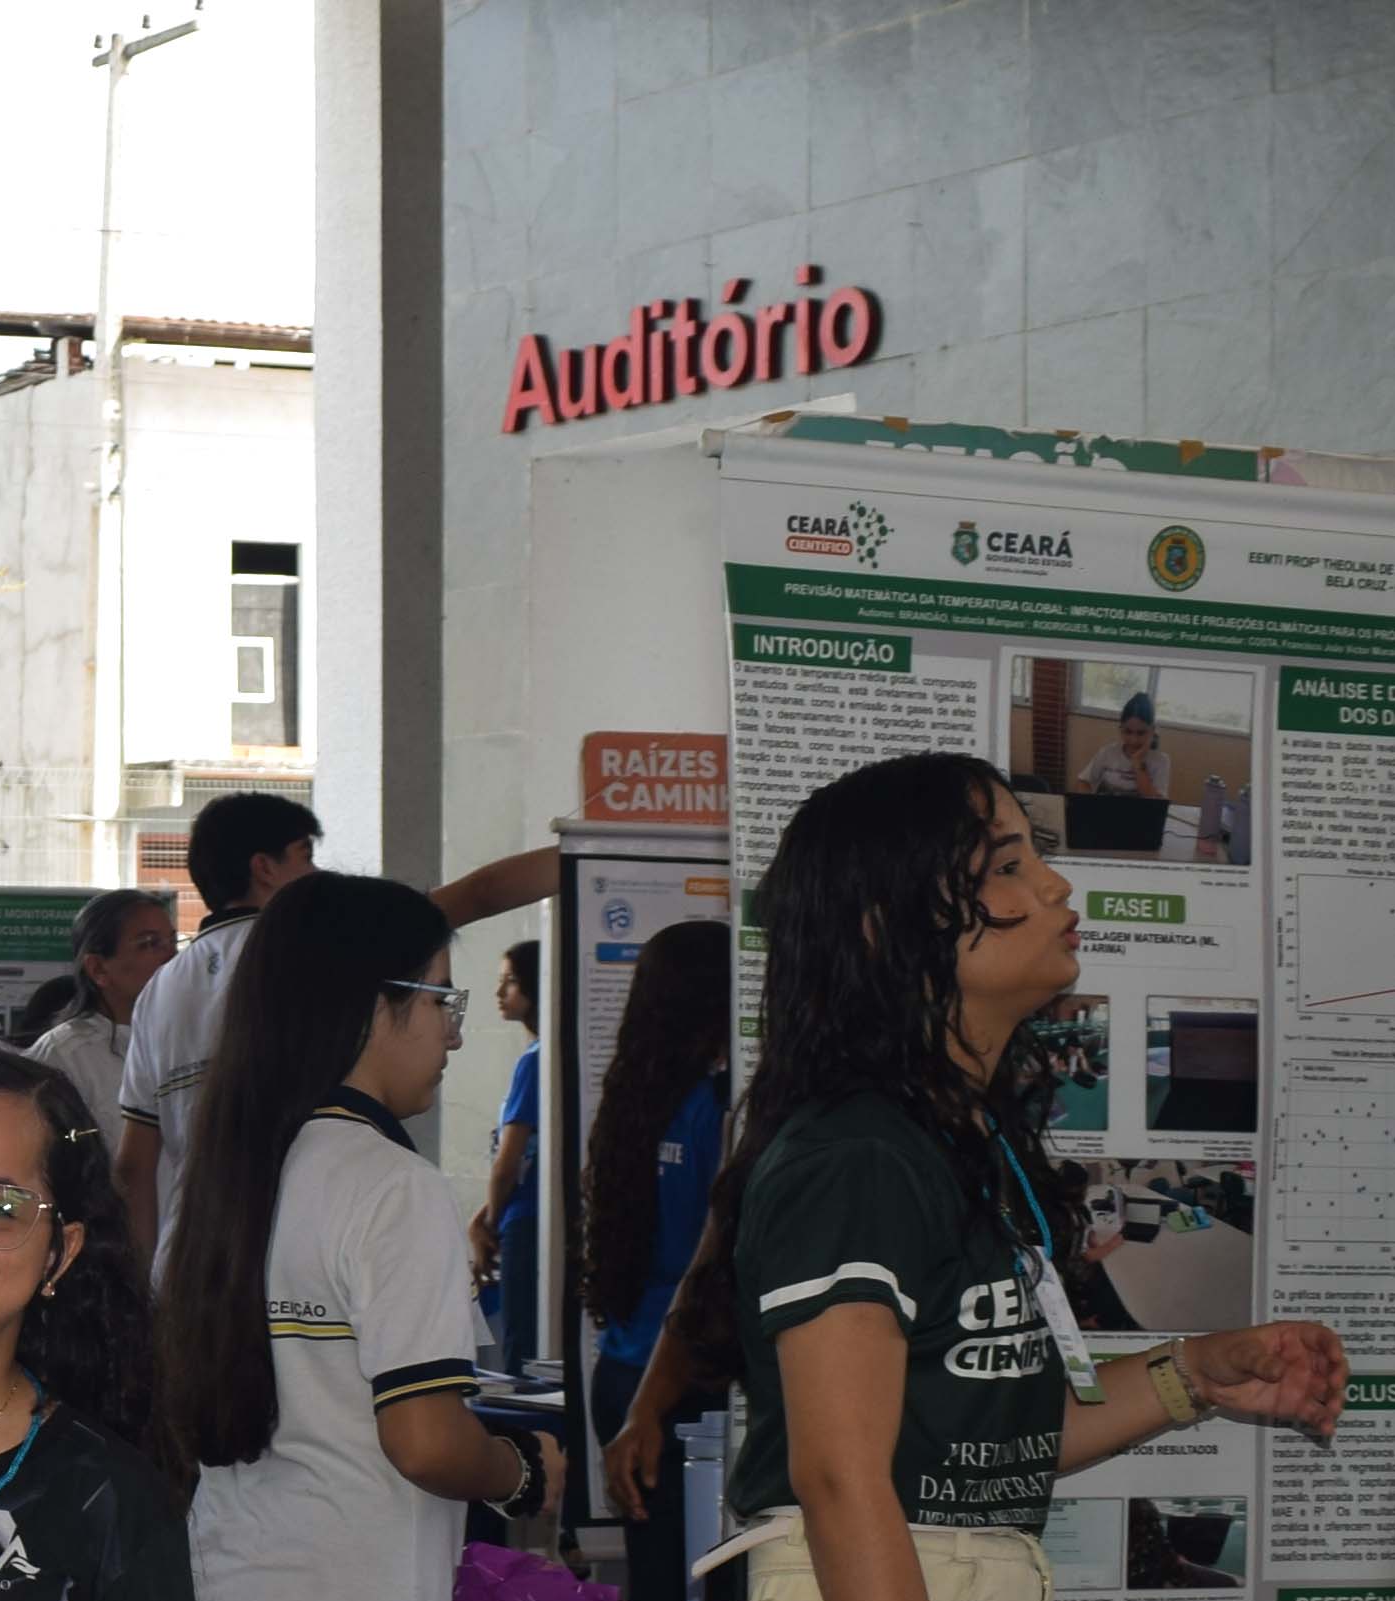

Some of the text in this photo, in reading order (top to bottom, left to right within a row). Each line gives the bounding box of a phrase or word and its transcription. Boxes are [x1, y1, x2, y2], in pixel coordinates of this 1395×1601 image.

[502, 264, 877, 433] Auditório
[787, 515, 851, 537] CEARÁ
[788, 538, 851, 555] CIENTÍFICO
[986, 531, 1073, 558] CEARÁ
[753, 634, 894, 666] INTRODUÇÃO
[1291, 677, 1383, 701] ANÁLISE E
[1339, 706, 1378, 725] DOS
[601, 748, 718, 779] RAÍZES
[1103, 896, 1169, 918] FASE II
[920, 1475, 956, 1501] DA
